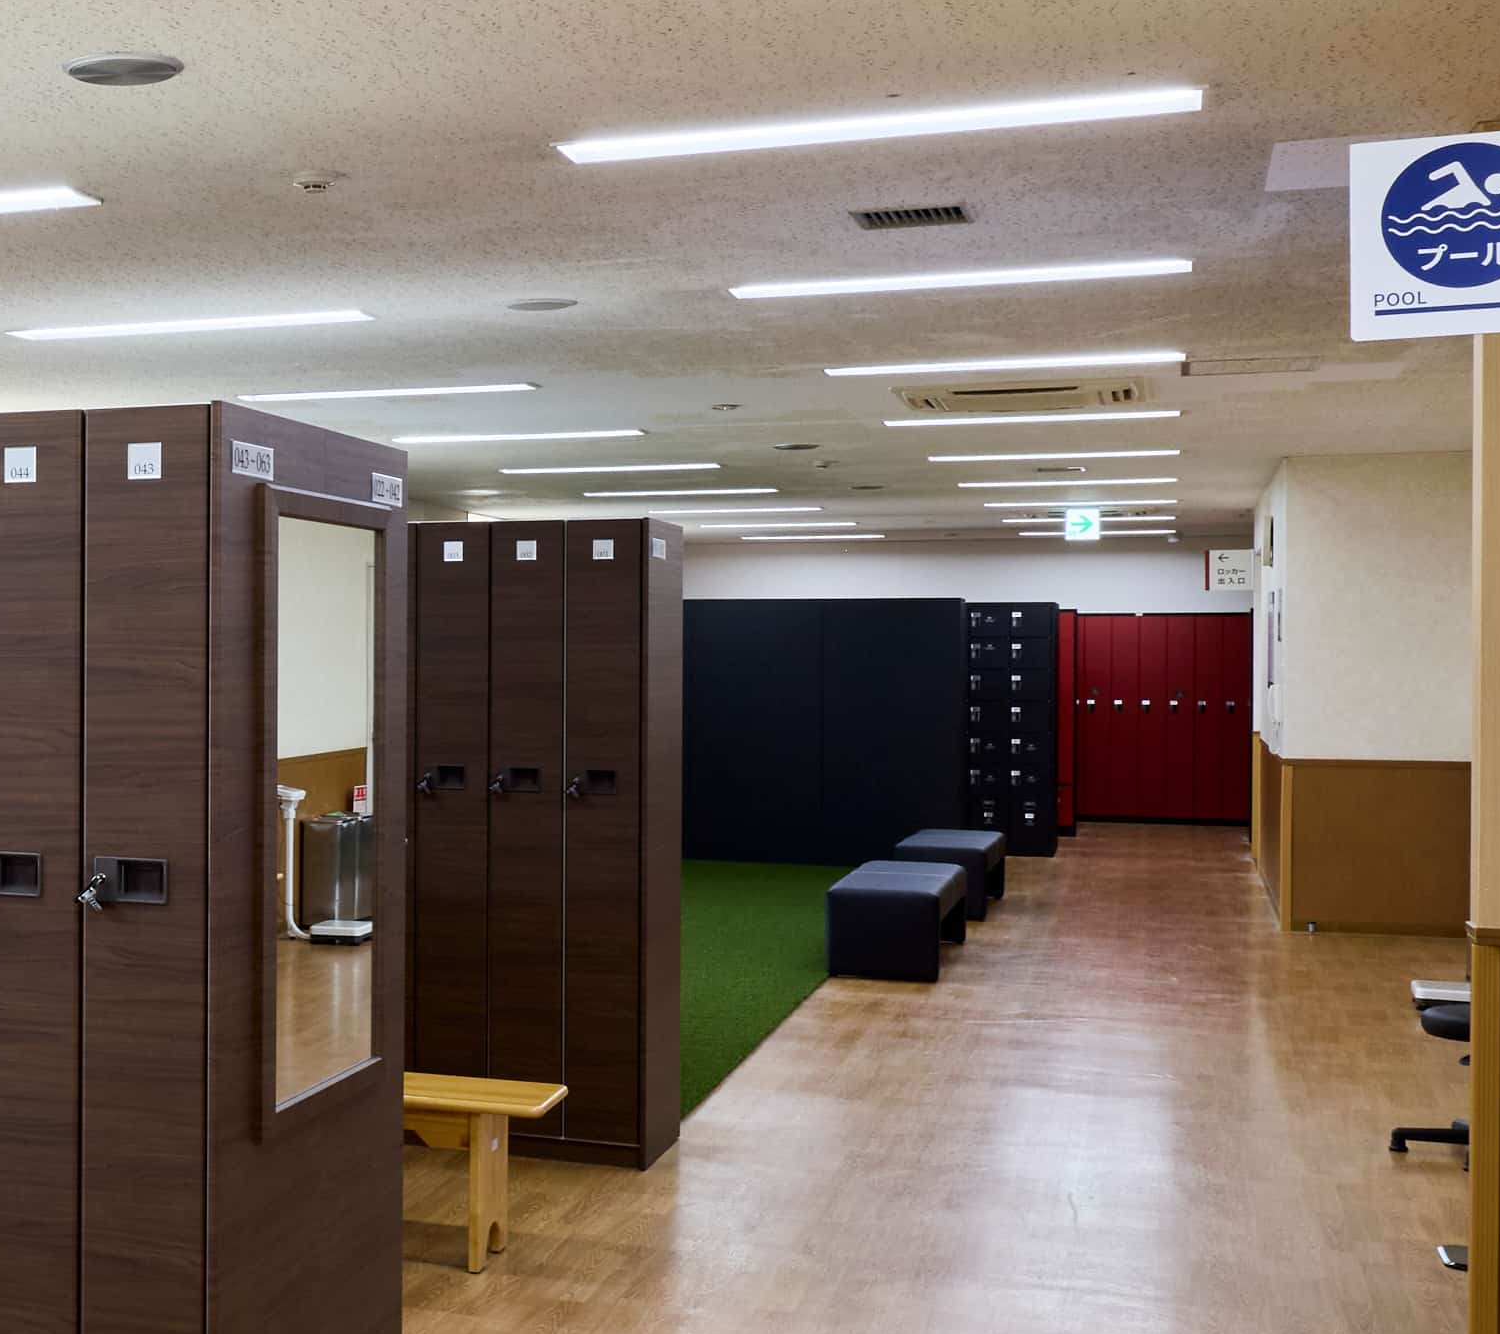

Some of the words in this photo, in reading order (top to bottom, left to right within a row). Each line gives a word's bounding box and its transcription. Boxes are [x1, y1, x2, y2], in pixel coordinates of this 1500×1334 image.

[1374, 291, 1427, 307] POOL
[10, 467, 29, 479] 044
[134, 463, 154, 475] 043
[1217, 568, 1248, 576] ロッカー
[1218, 577, 1246, 585] 出入口
